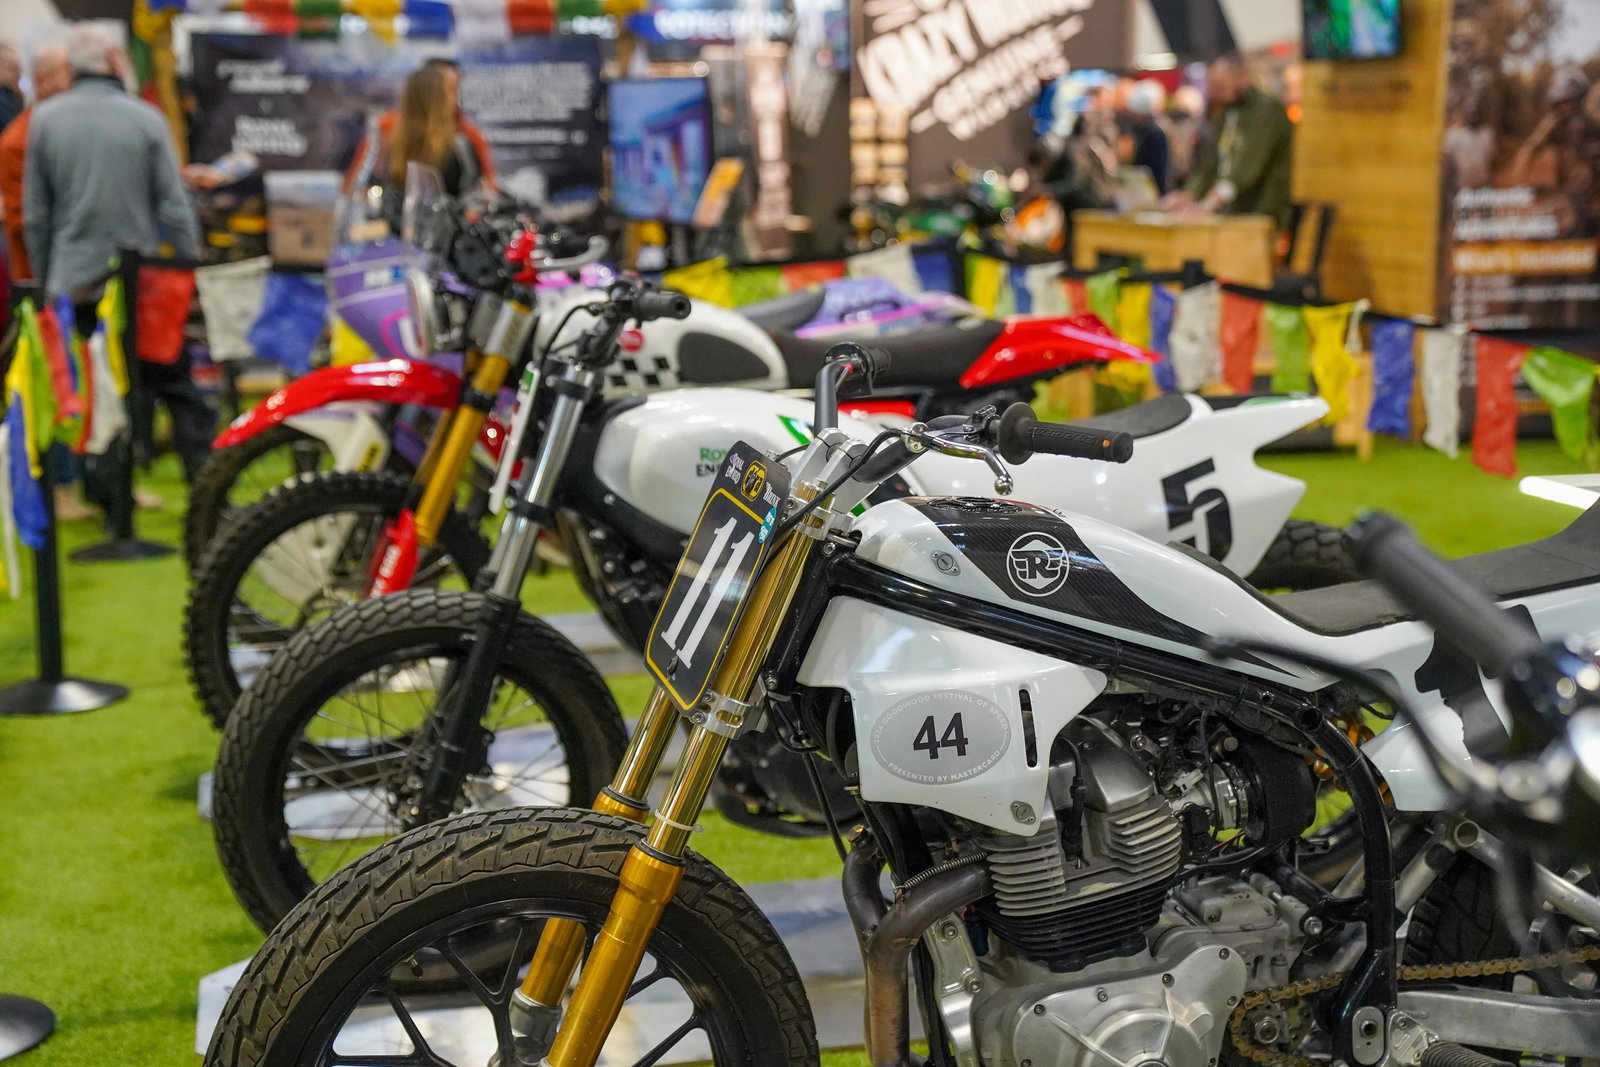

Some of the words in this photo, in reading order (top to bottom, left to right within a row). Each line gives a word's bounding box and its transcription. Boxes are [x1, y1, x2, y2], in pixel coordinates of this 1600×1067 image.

[1161, 457, 1232, 562] 5
[661, 517, 755, 669] 11
[882, 695, 930, 724] GOODWOOD
[933, 693, 974, 703] FESTIVAL
[977, 699, 989, 708] OF
[989, 706, 1008, 730] SPEED
[912, 712, 968, 759] 44
[887, 762, 934, 782] PRESENTED
[950, 750, 1000, 781] MASTERCARD
